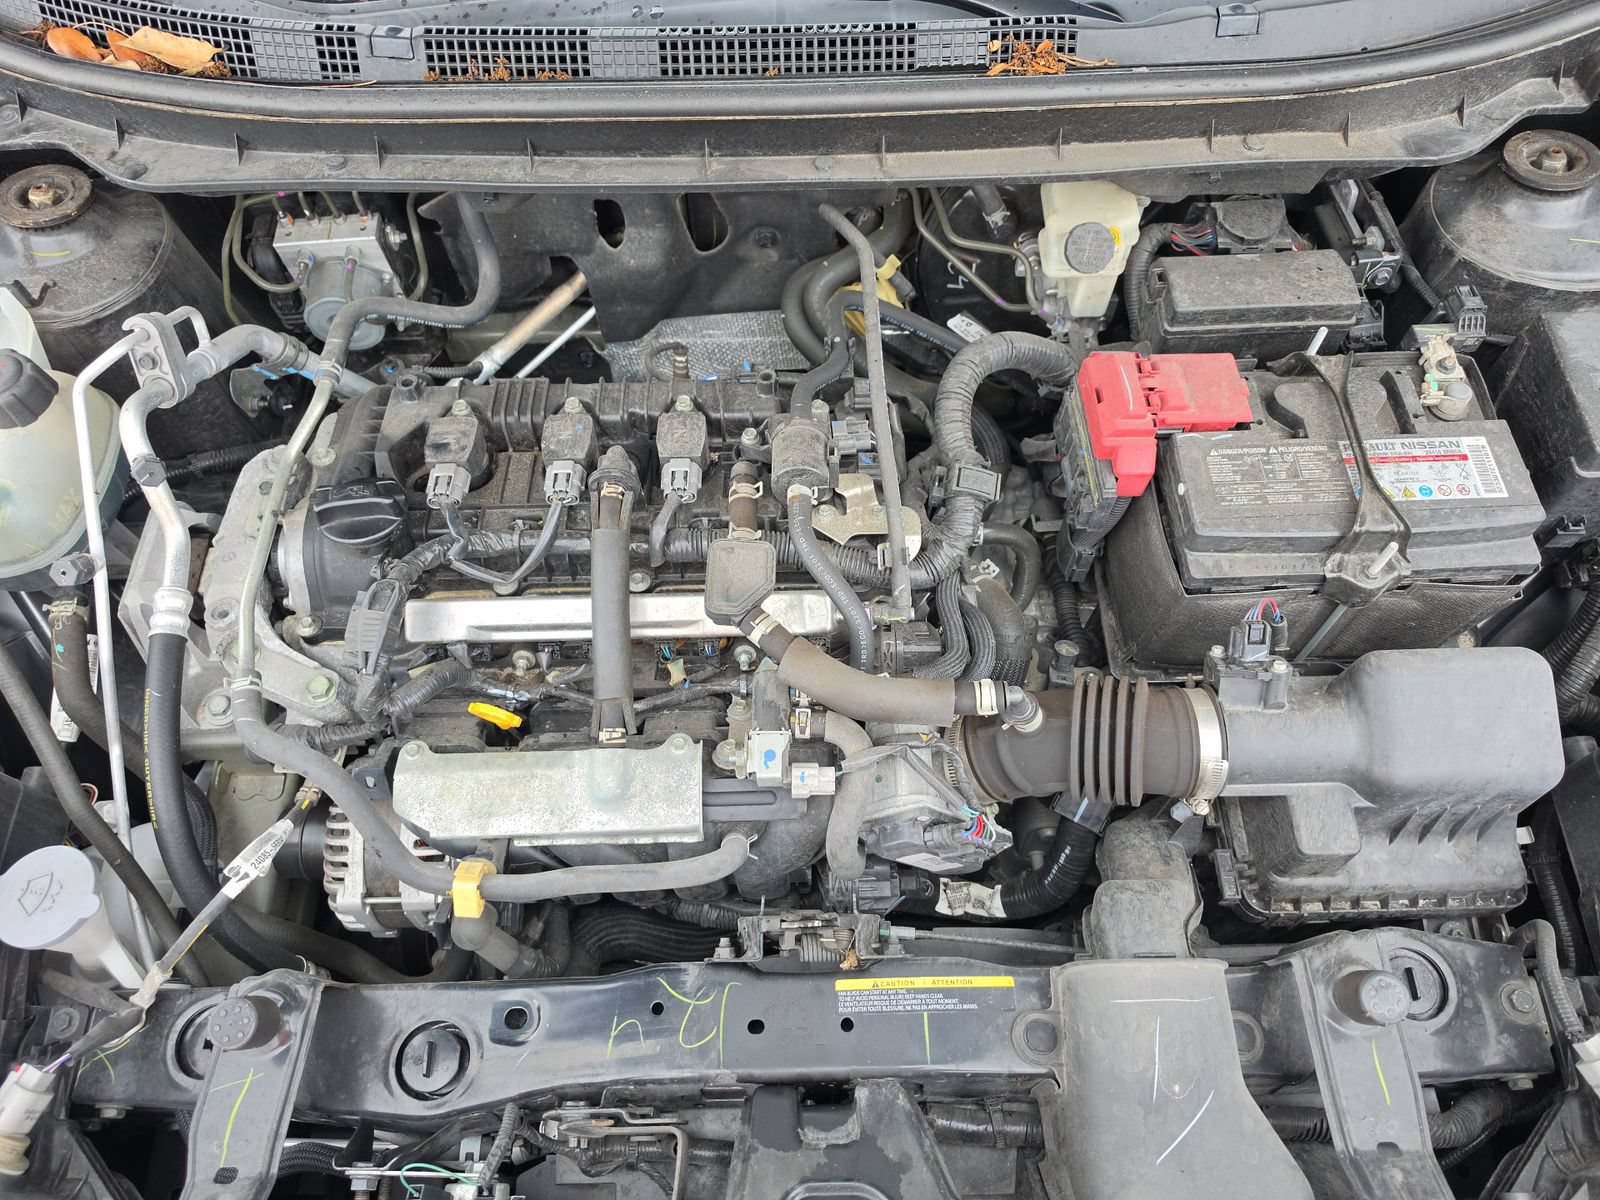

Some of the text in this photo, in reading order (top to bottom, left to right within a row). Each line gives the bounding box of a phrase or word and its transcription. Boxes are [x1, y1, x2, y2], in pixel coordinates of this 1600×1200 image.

[1217, 447, 1266, 455] DANGER/POISON
[1342, 440, 1462, 452] RAULT NISSAN
